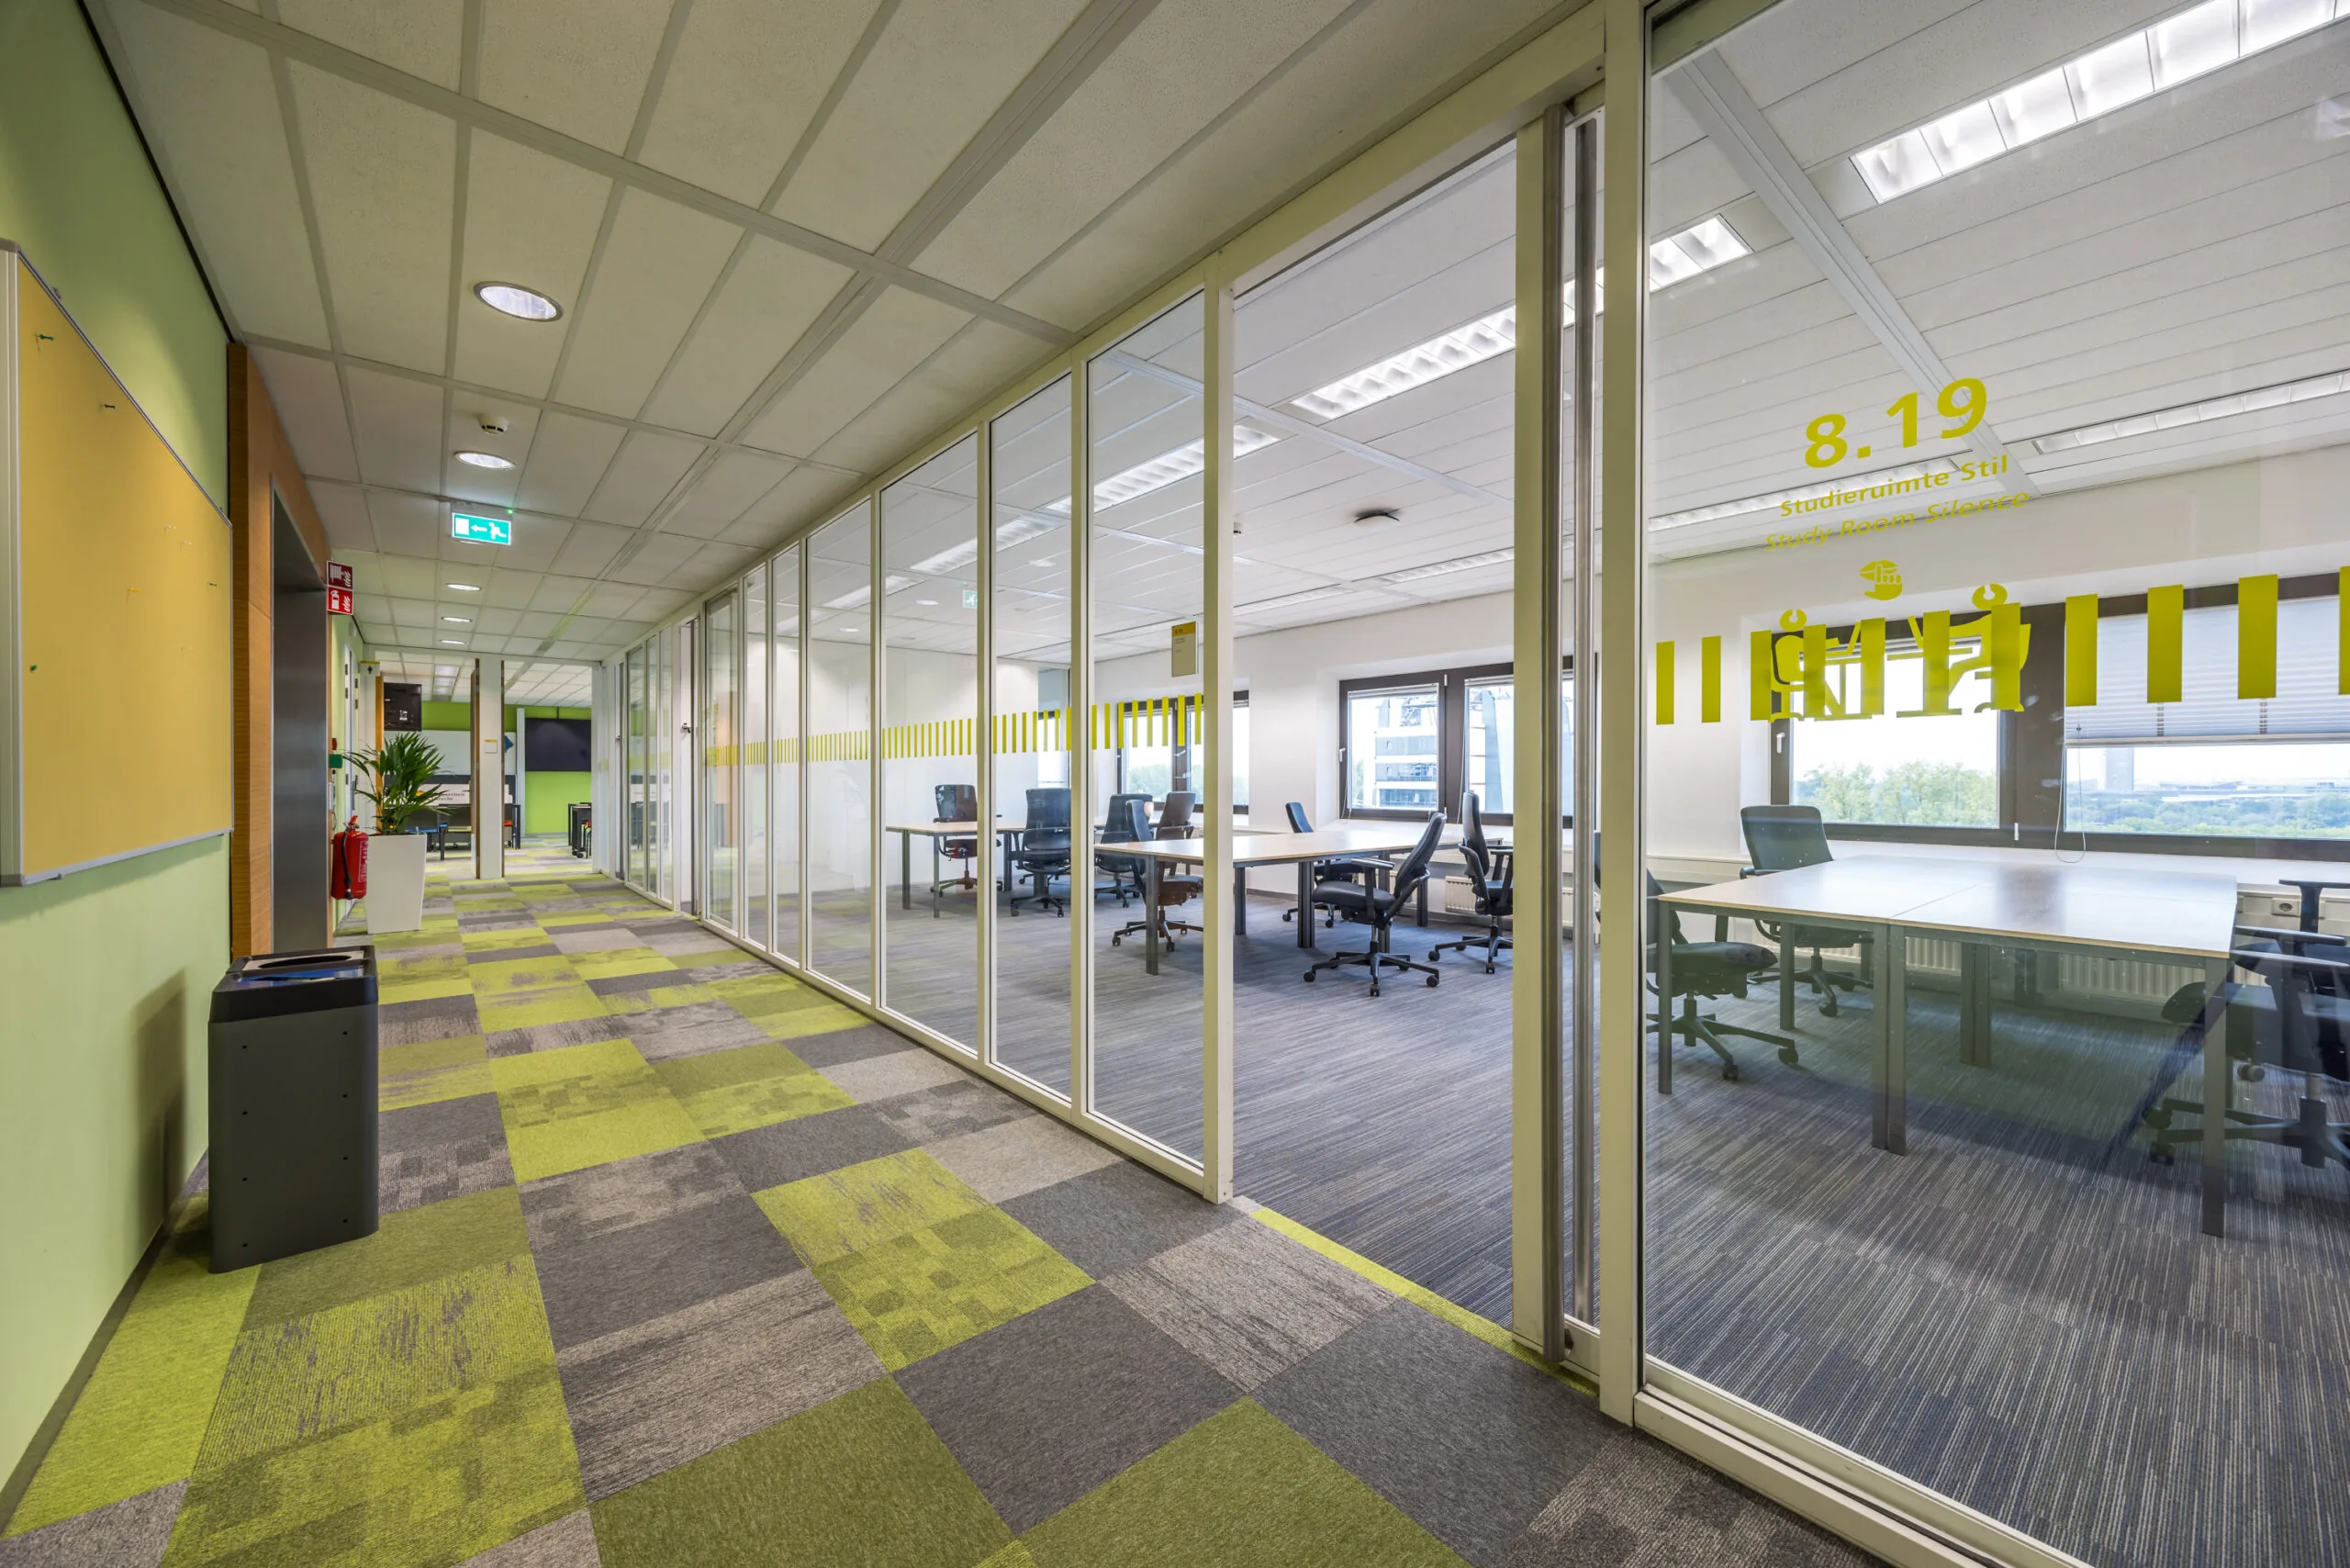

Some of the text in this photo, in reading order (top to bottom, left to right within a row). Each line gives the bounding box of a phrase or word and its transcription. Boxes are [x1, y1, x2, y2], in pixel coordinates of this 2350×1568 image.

[1805, 377, 1988, 468] 8.19
[1780, 454, 2009, 518] Studieruimte Stil
[1763, 492, 2030, 552] Study Room Silence
